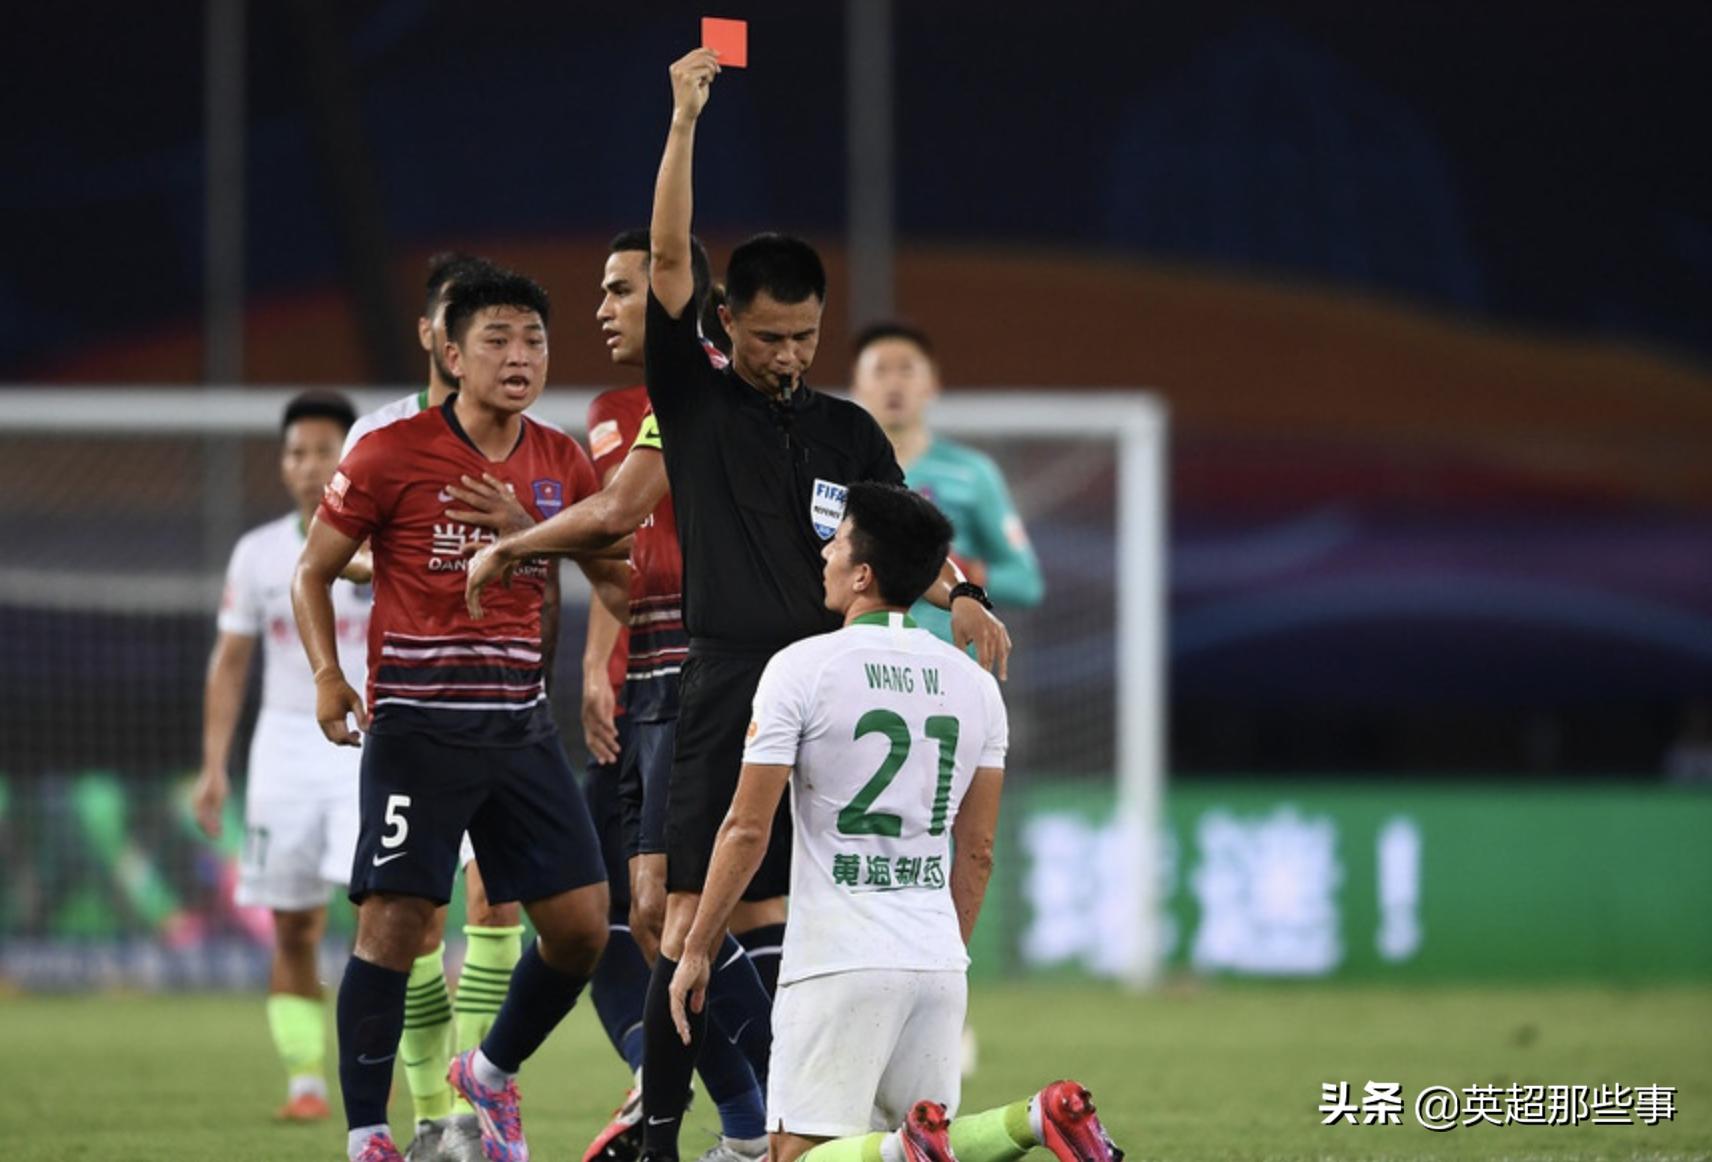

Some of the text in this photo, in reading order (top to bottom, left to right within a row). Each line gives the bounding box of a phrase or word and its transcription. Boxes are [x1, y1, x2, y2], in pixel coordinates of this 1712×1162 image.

[817, 483, 848, 504] FIFA
[864, 662, 945, 696] WANG W.
[836, 708, 960, 838] 21
[381, 794, 412, 849] 5
[832, 853, 946, 889] 黄海制药
